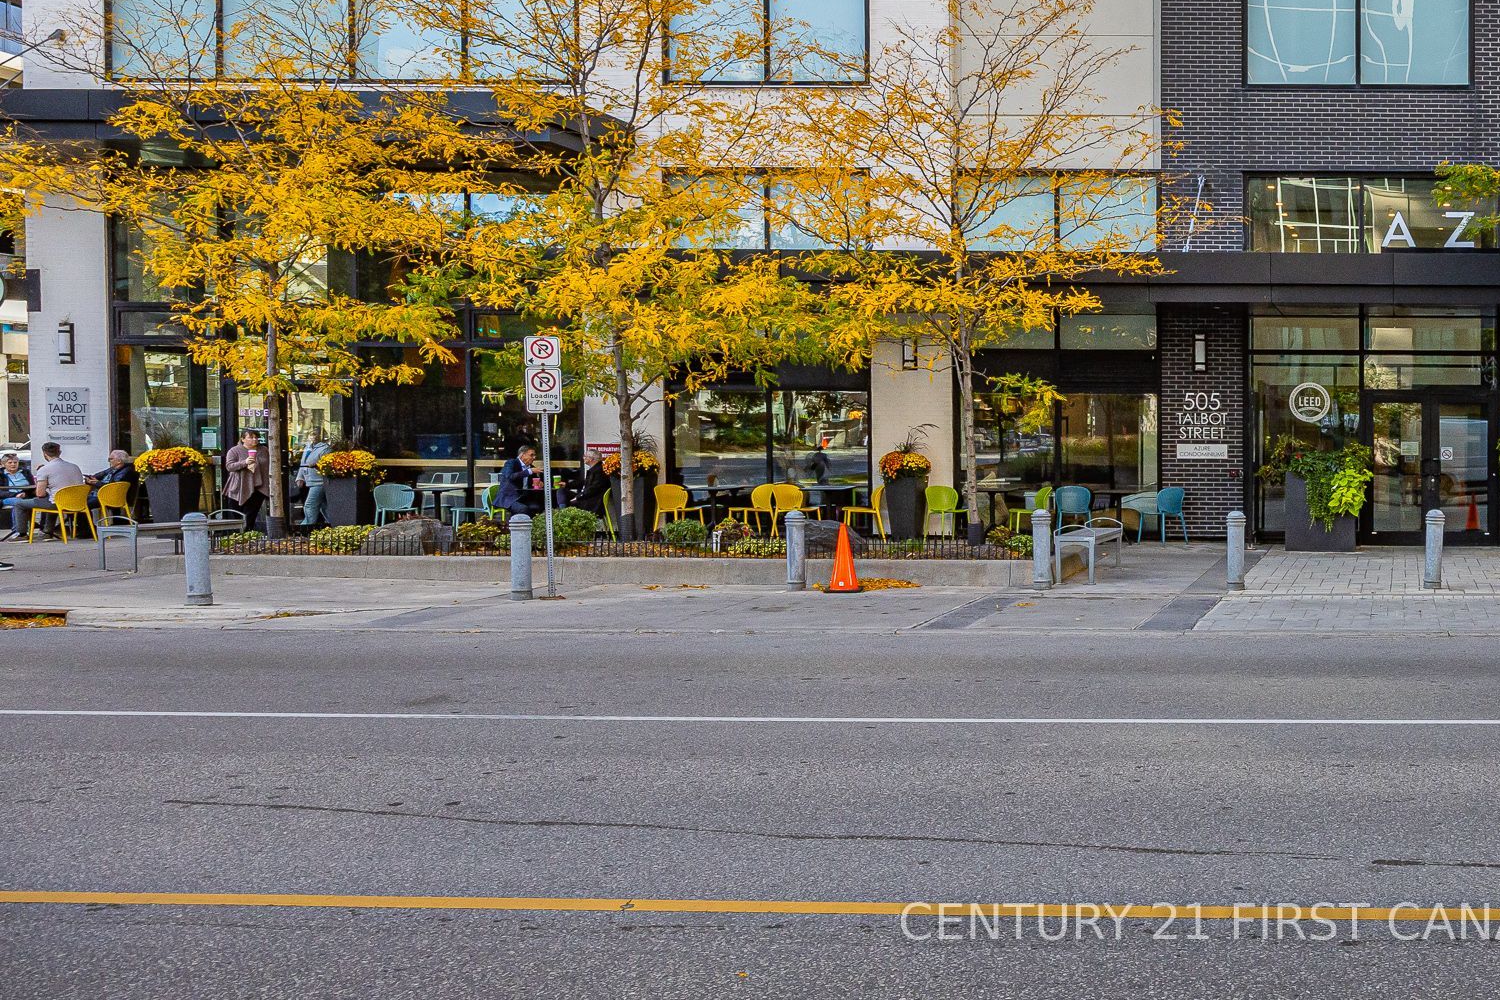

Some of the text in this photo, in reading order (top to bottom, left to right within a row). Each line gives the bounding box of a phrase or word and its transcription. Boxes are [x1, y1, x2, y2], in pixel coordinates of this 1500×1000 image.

[57, 391, 78, 402] 503
[1183, 392, 1221, 411] 505
[1298, 396, 1321, 407] LEED
[47, 403, 88, 414] TALBOT
[239, 408, 269, 417] RESE
[50, 415, 86, 426] STREET
[1176, 412, 1228, 425] TALBOT
[1179, 426, 1226, 439] STREET
